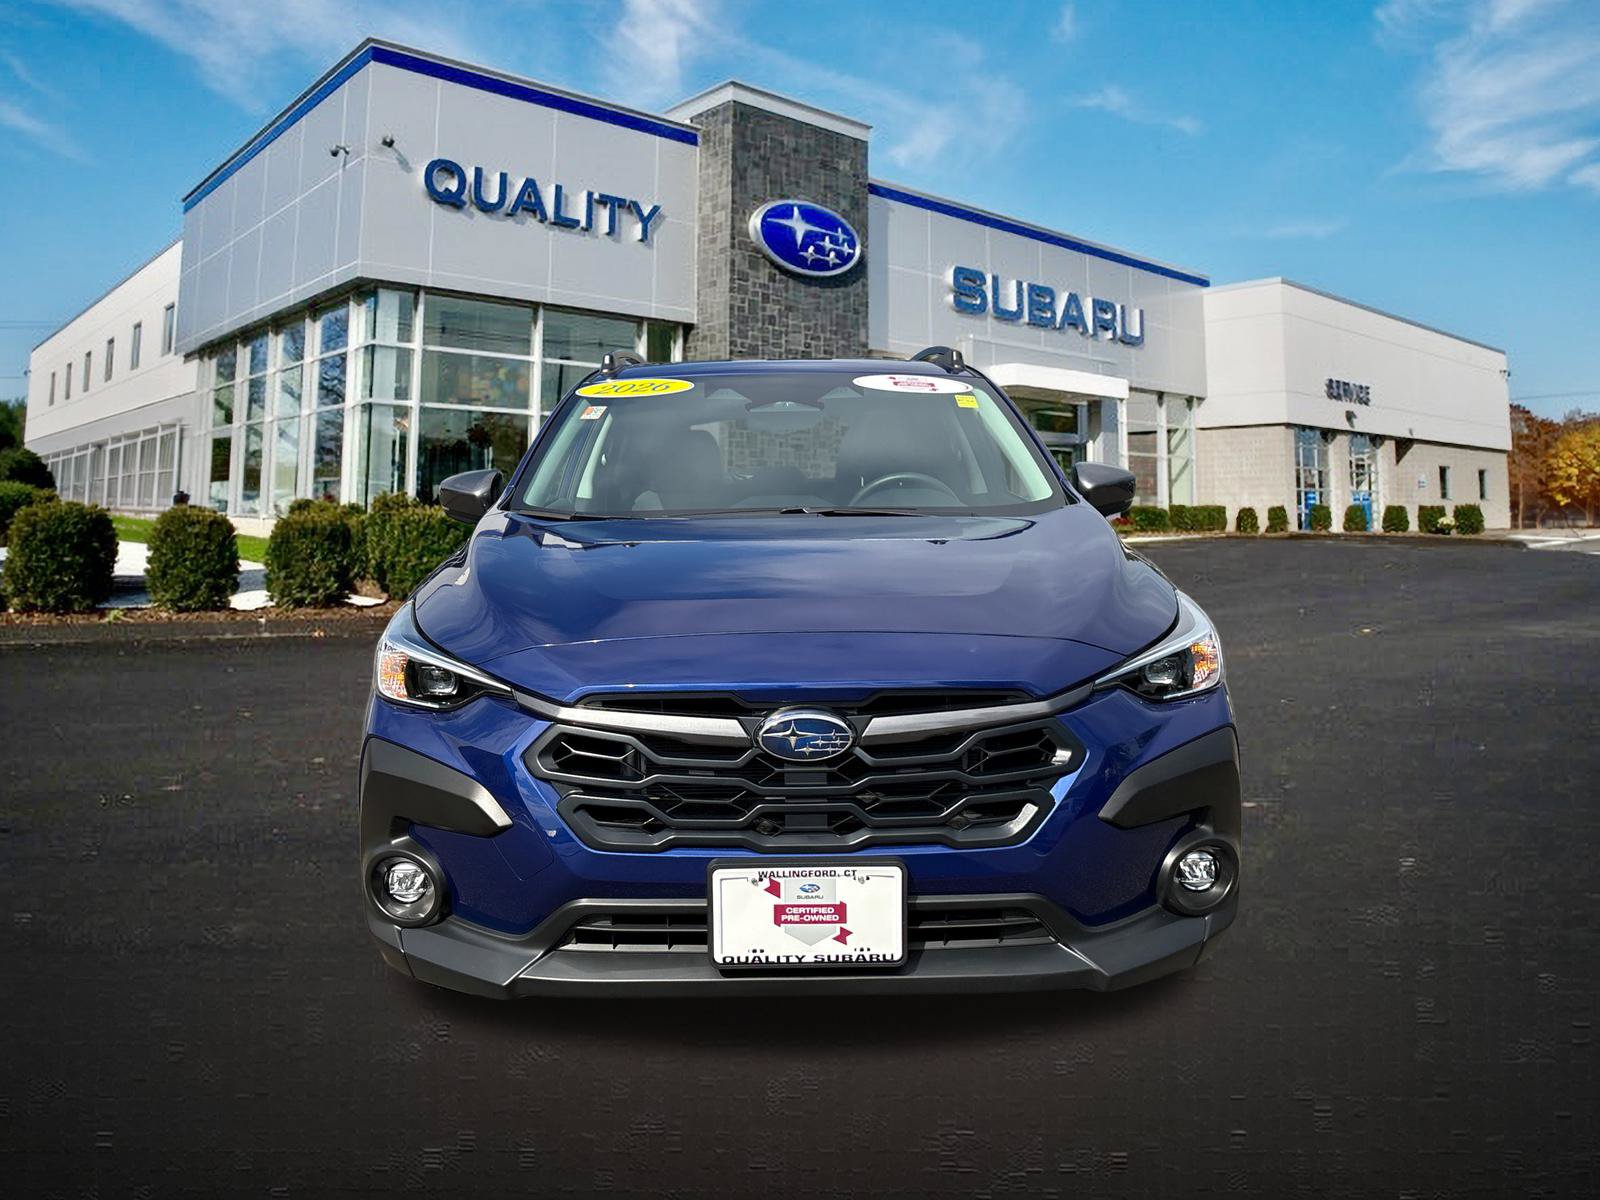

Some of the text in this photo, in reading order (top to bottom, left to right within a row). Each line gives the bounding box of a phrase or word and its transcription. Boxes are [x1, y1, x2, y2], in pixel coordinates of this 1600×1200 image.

[423, 158, 661, 243] QUALITY
[948, 265, 1145, 347] SUBARU
[593, 383, 675, 395] 2026
[844, 869, 857, 878] CT
[781, 914, 840, 922] PRE-OWNED
[722, 953, 894, 964] QUALITY SUBARU
